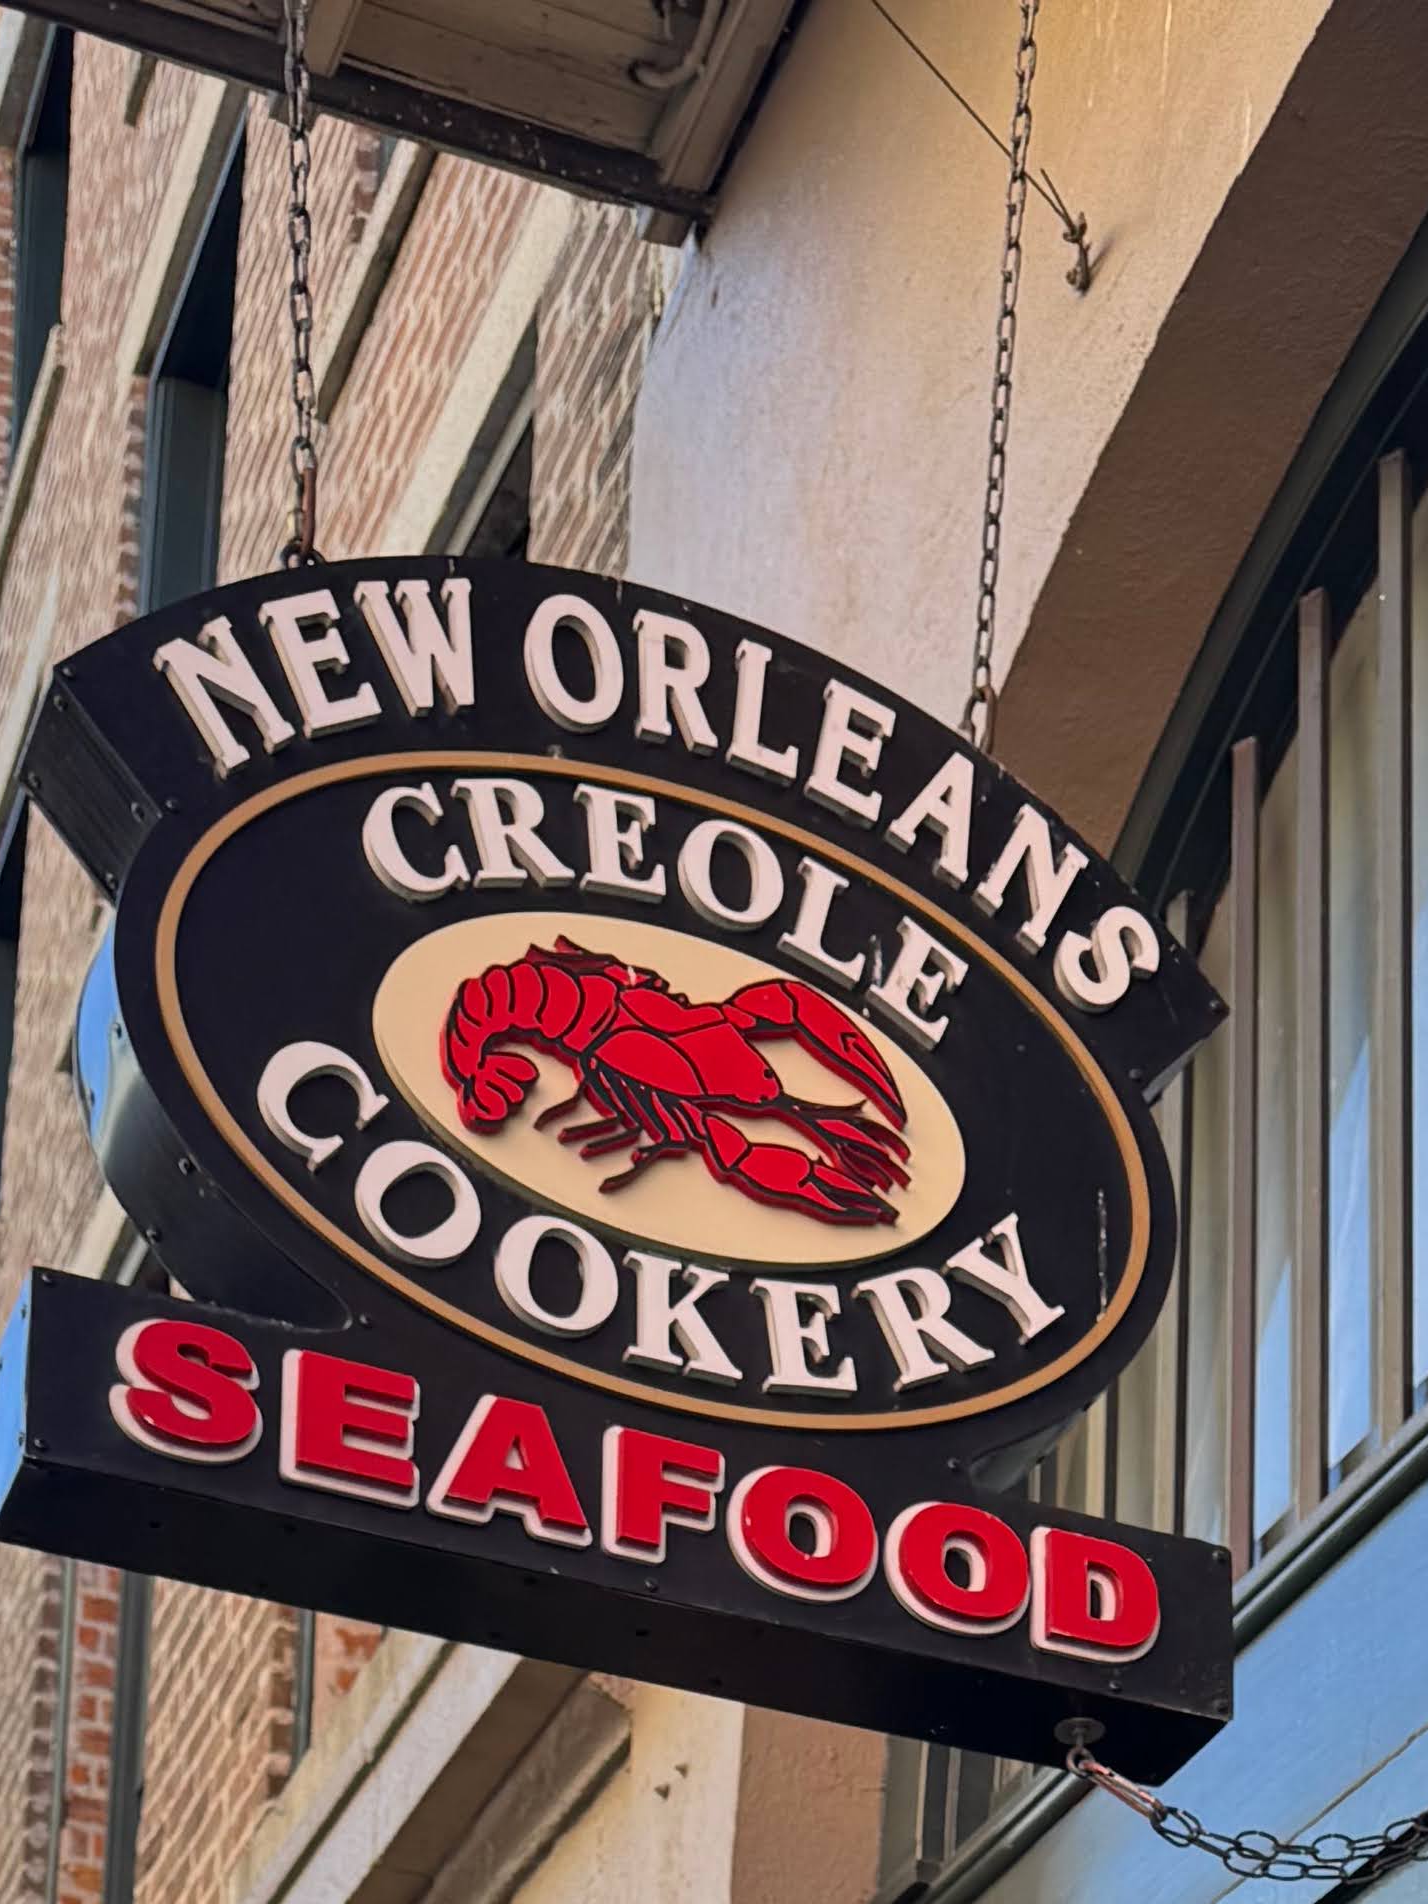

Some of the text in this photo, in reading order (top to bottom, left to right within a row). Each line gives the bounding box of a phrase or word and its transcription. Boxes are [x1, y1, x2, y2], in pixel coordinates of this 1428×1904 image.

[154, 576, 1161, 1012] NEW ORLEANS
[362, 775, 969, 1048] CREOLE
[257, 1040, 1065, 1396] COOKERY
[110, 1317, 1161, 1662] SEAFOOD
